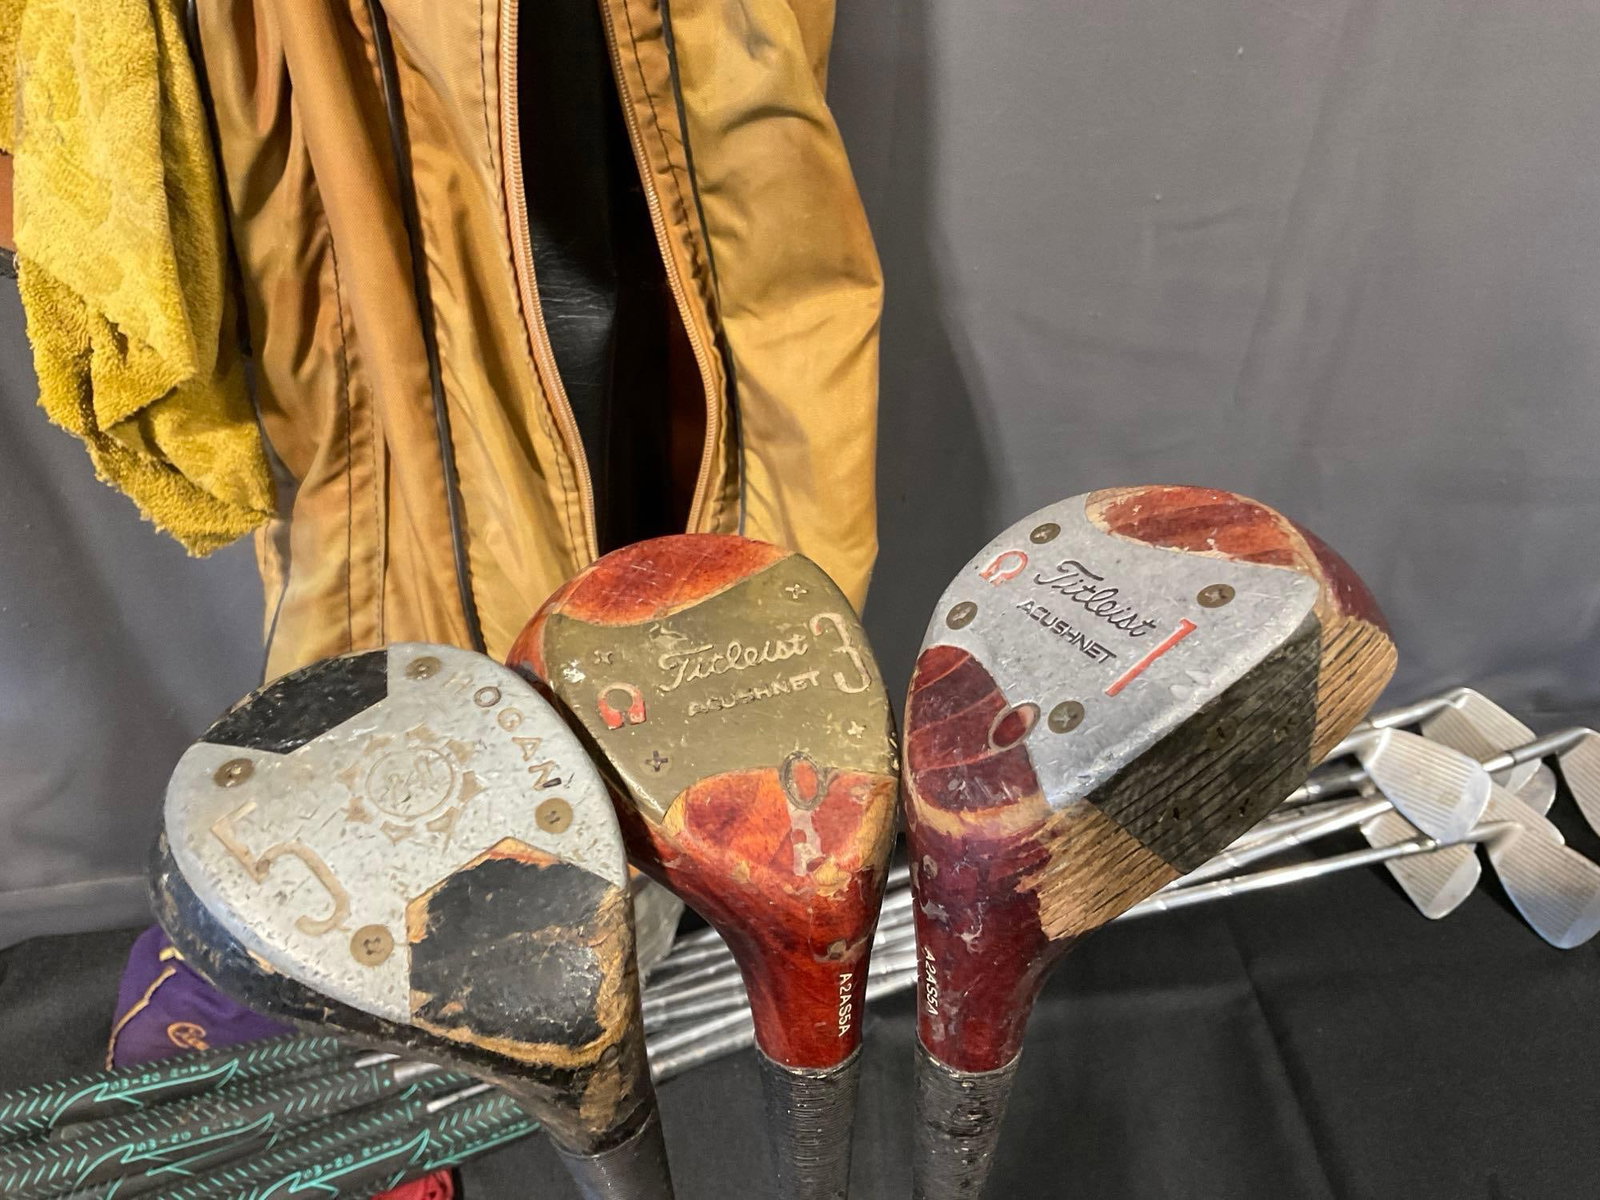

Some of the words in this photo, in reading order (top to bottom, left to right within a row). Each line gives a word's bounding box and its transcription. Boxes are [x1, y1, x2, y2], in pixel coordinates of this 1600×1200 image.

[1016, 600, 1117, 665] ACUSHNET
[1033, 559, 1156, 637] Titleist
[658, 634, 809, 692] Titleist
[808, 612, 872, 693] 3
[1104, 616, 1198, 697] 1
[688, 670, 820, 717] ACUSHNET
[210, 801, 351, 938] 5
[837, 972, 853, 1038] A2AS5A
[925, 946, 939, 1016] A2AS5A
